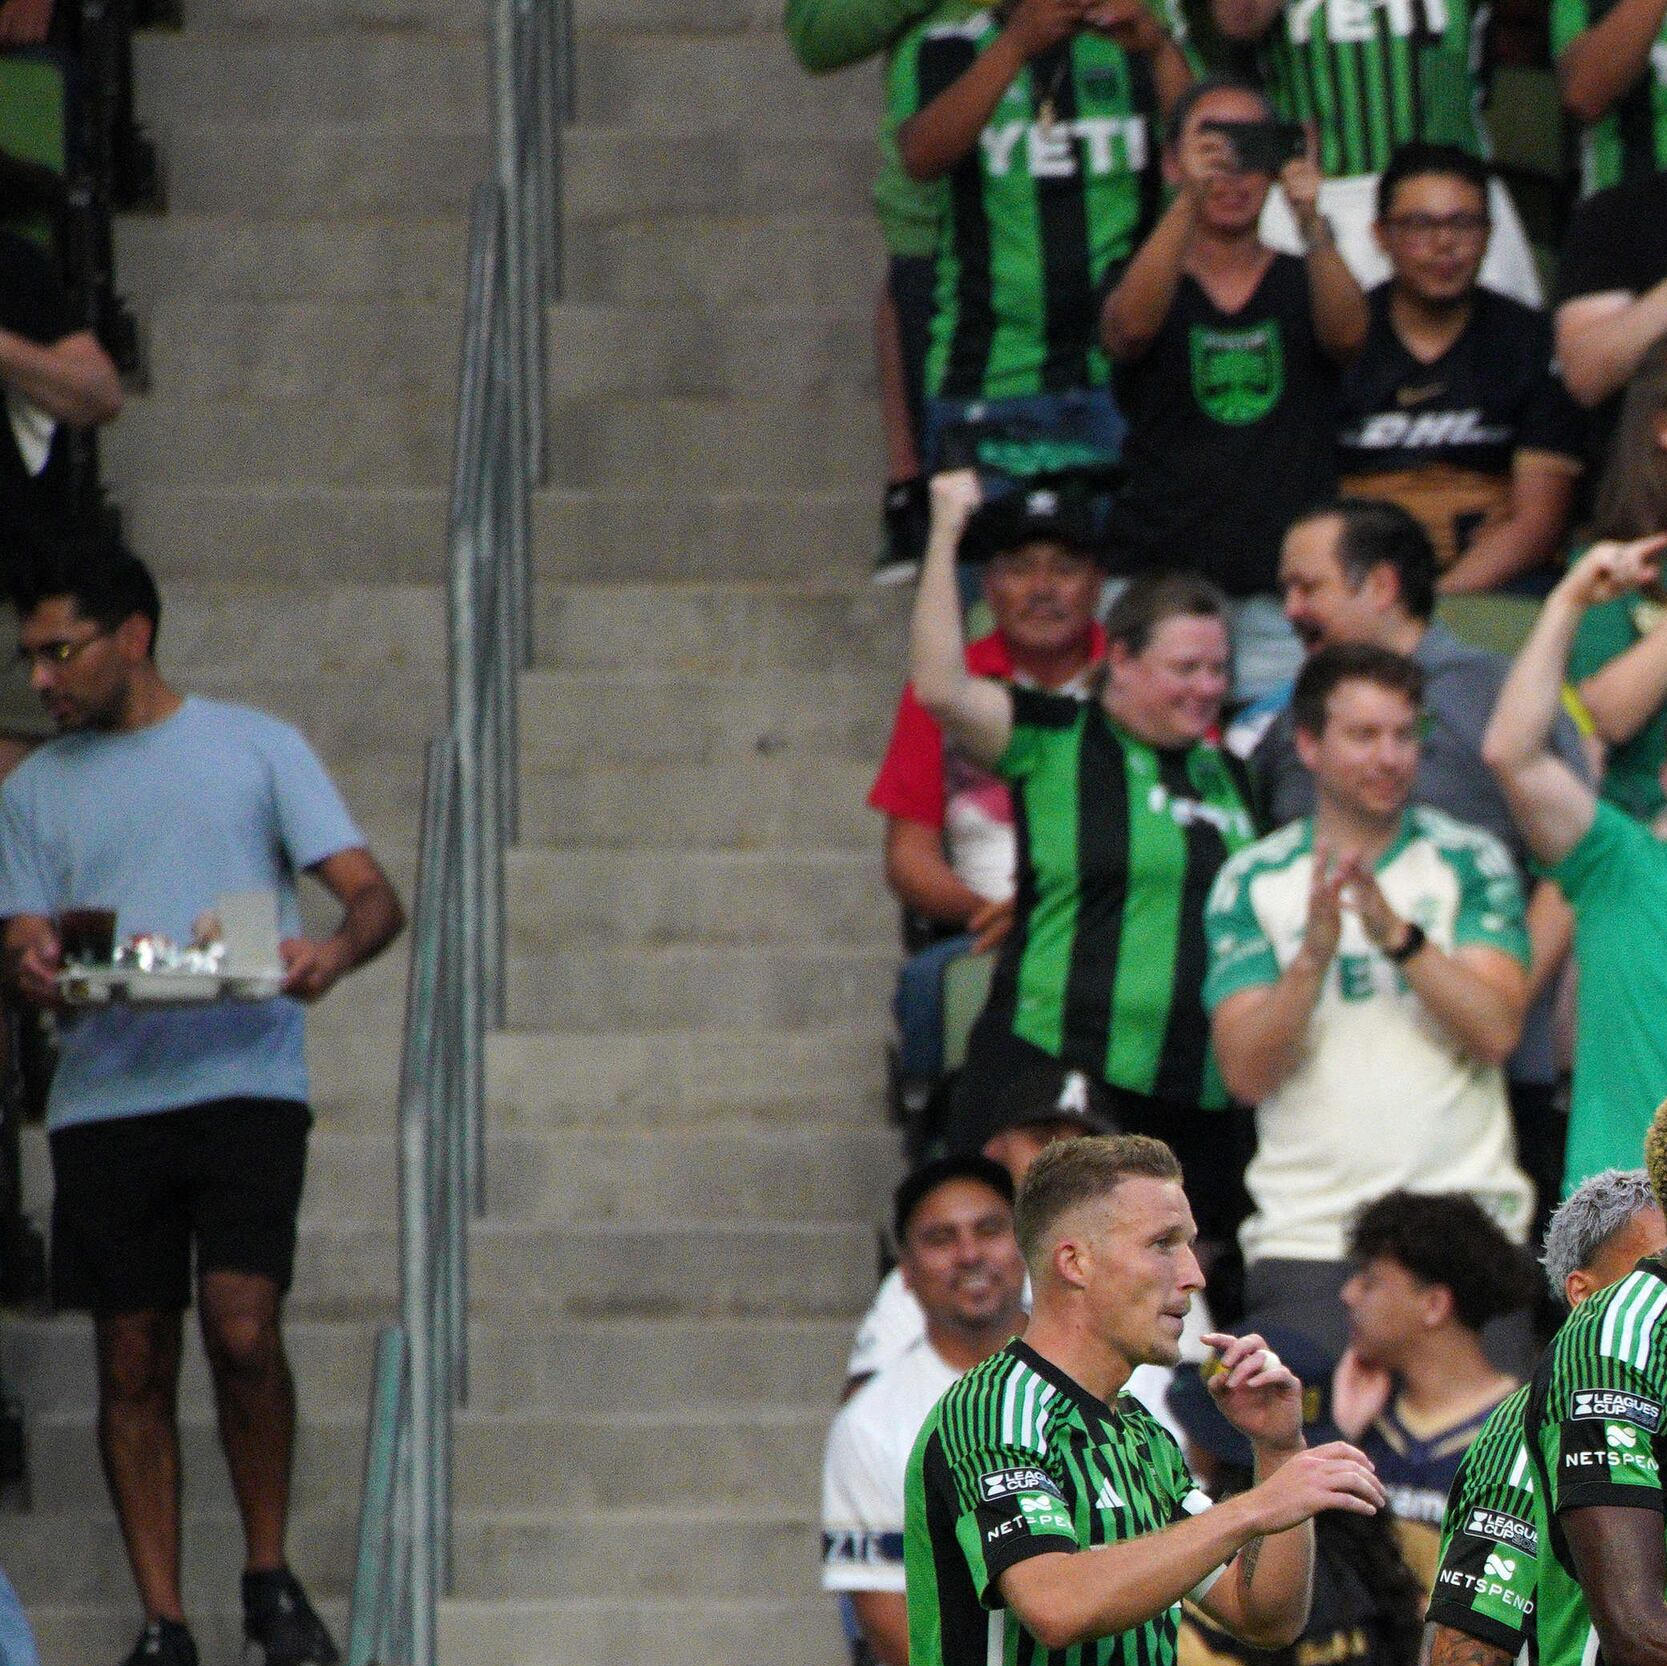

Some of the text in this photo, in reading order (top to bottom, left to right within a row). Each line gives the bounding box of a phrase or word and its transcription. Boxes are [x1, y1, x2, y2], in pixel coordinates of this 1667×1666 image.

[980, 118, 1148, 177] YETI
[1593, 1403, 1627, 1414] CUP
[1594, 1393, 1660, 1418] LEAGUES
[1565, 1451, 1660, 1472] NETSPEN
[1006, 1479, 1040, 1490] CUP
[1484, 1523, 1515, 1539] CUP
[1439, 1568, 1535, 1615] NETSPEND
